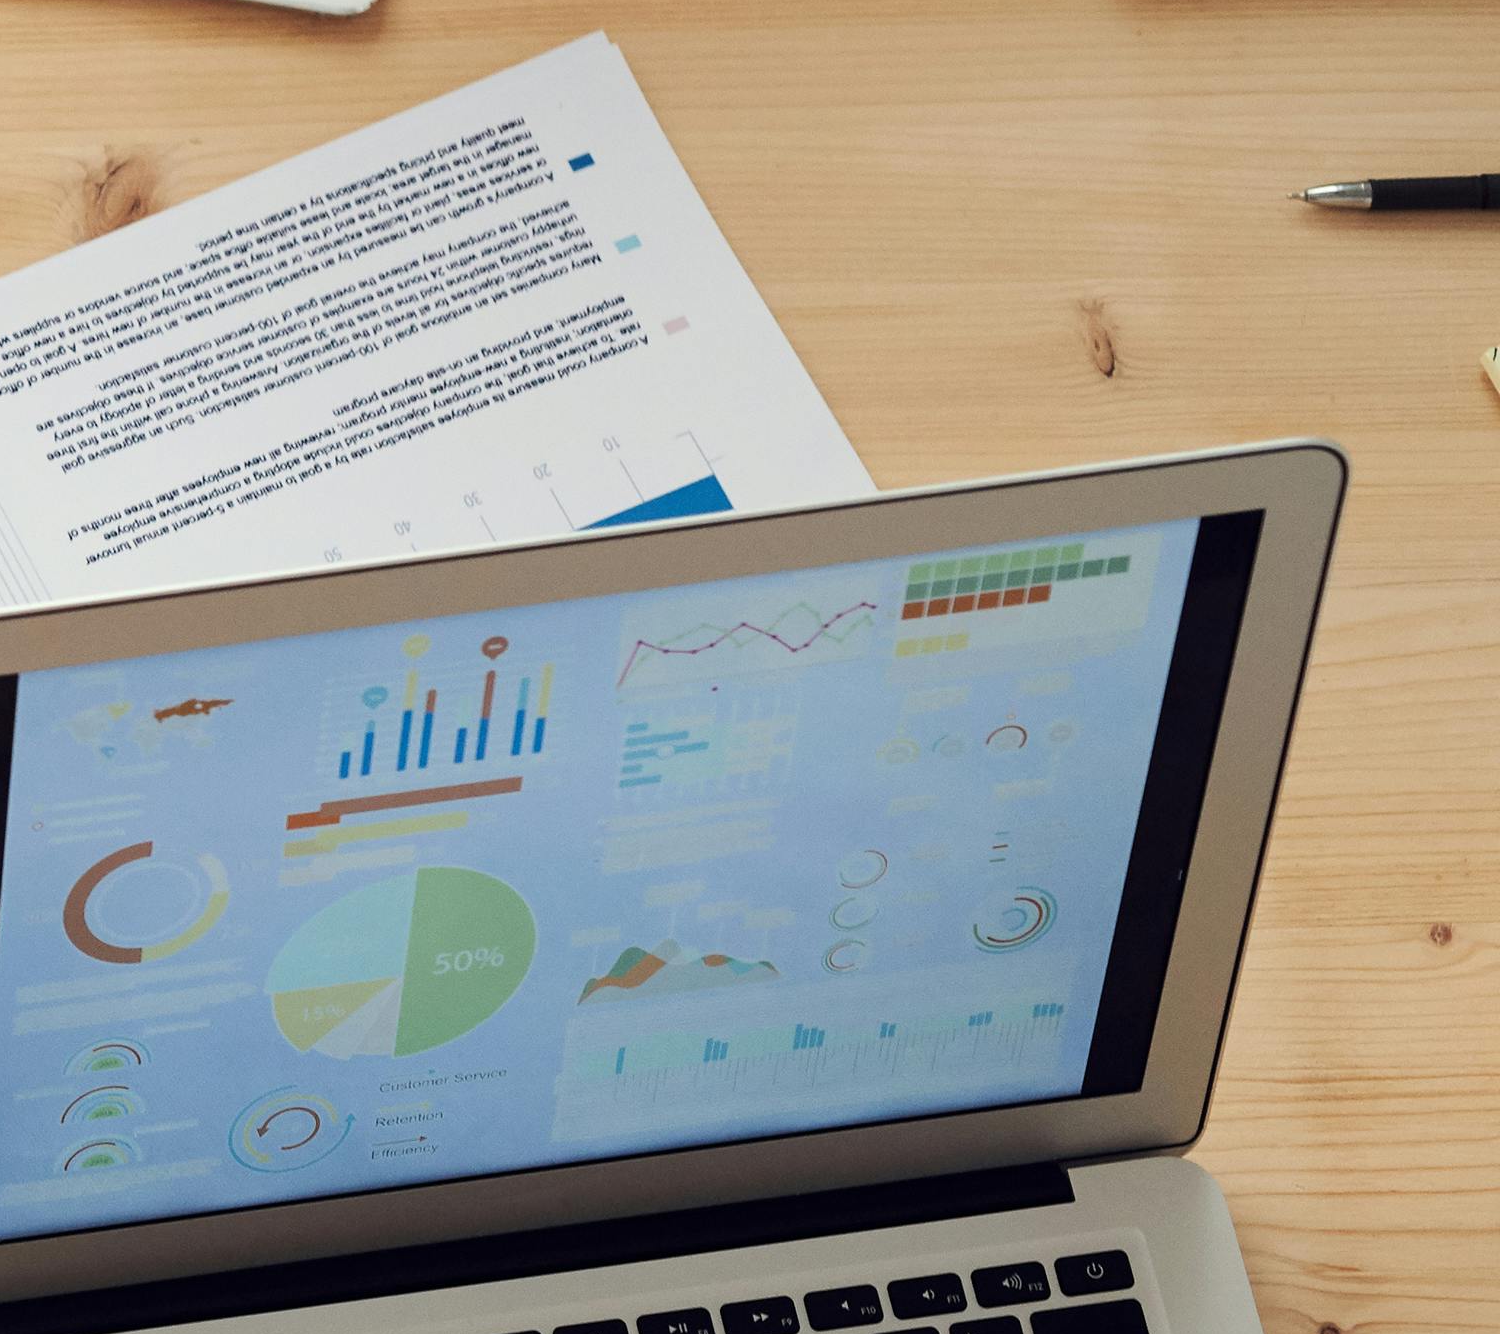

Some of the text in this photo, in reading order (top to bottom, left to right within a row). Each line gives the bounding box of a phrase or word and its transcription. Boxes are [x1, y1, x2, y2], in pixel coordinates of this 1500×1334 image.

[531, 322, 555, 340] and
[599, 332, 617, 344] To
[479, 329, 533, 359] providing
[518, 332, 573, 360] instituting
[555, 338, 599, 362] achieve
[425, 358, 464, 381] on-site
[462, 352, 481, 365] an
[508, 353, 519, 364] a
[531, 355, 556, 373] that
[379, 374, 426, 399] daycare
[428, 357, 509, 396] new-employee
[483, 376, 504, 391] the
[331, 389, 380, 418] program
[389, 389, 429, 413] mentor
[432, 384, 483, 412] company
[375, 405, 432, 434] objectives
[281, 426, 337, 454] reviewing
[343, 427, 375, 448] could
[601, 435, 621, 453] 10
[84, 333, 650, 567] A company could measure its employee satisfaction rate by a goal to maintain a 5-percent annual turnover
[242, 452, 268, 471] new
[267, 446, 283, 462] all
[302, 440, 345, 463] include
[180, 463, 242, 494] employees
[242, 475, 253, 486] a
[251, 456, 302, 483] adopting
[531, 462, 552, 481] 20
[122, 498, 155, 517] three
[154, 487, 181, 506] after
[157, 479, 243, 520] comprehensive
[462, 491, 483, 508] 30
[79, 510, 123, 534] months
[102, 513, 158, 542] employee
[393, 520, 412, 536] 40
[66, 527, 80, 543] of
[322, 546, 344, 566] 50
[432, 943, 505, 977] 50%
[300, 1002, 347, 1024] 15%
[378, 1065, 508, 1095] Customer Service
[374, 1108, 445, 1130] Retention
[370, 1141, 440, 1164] Efficiency
